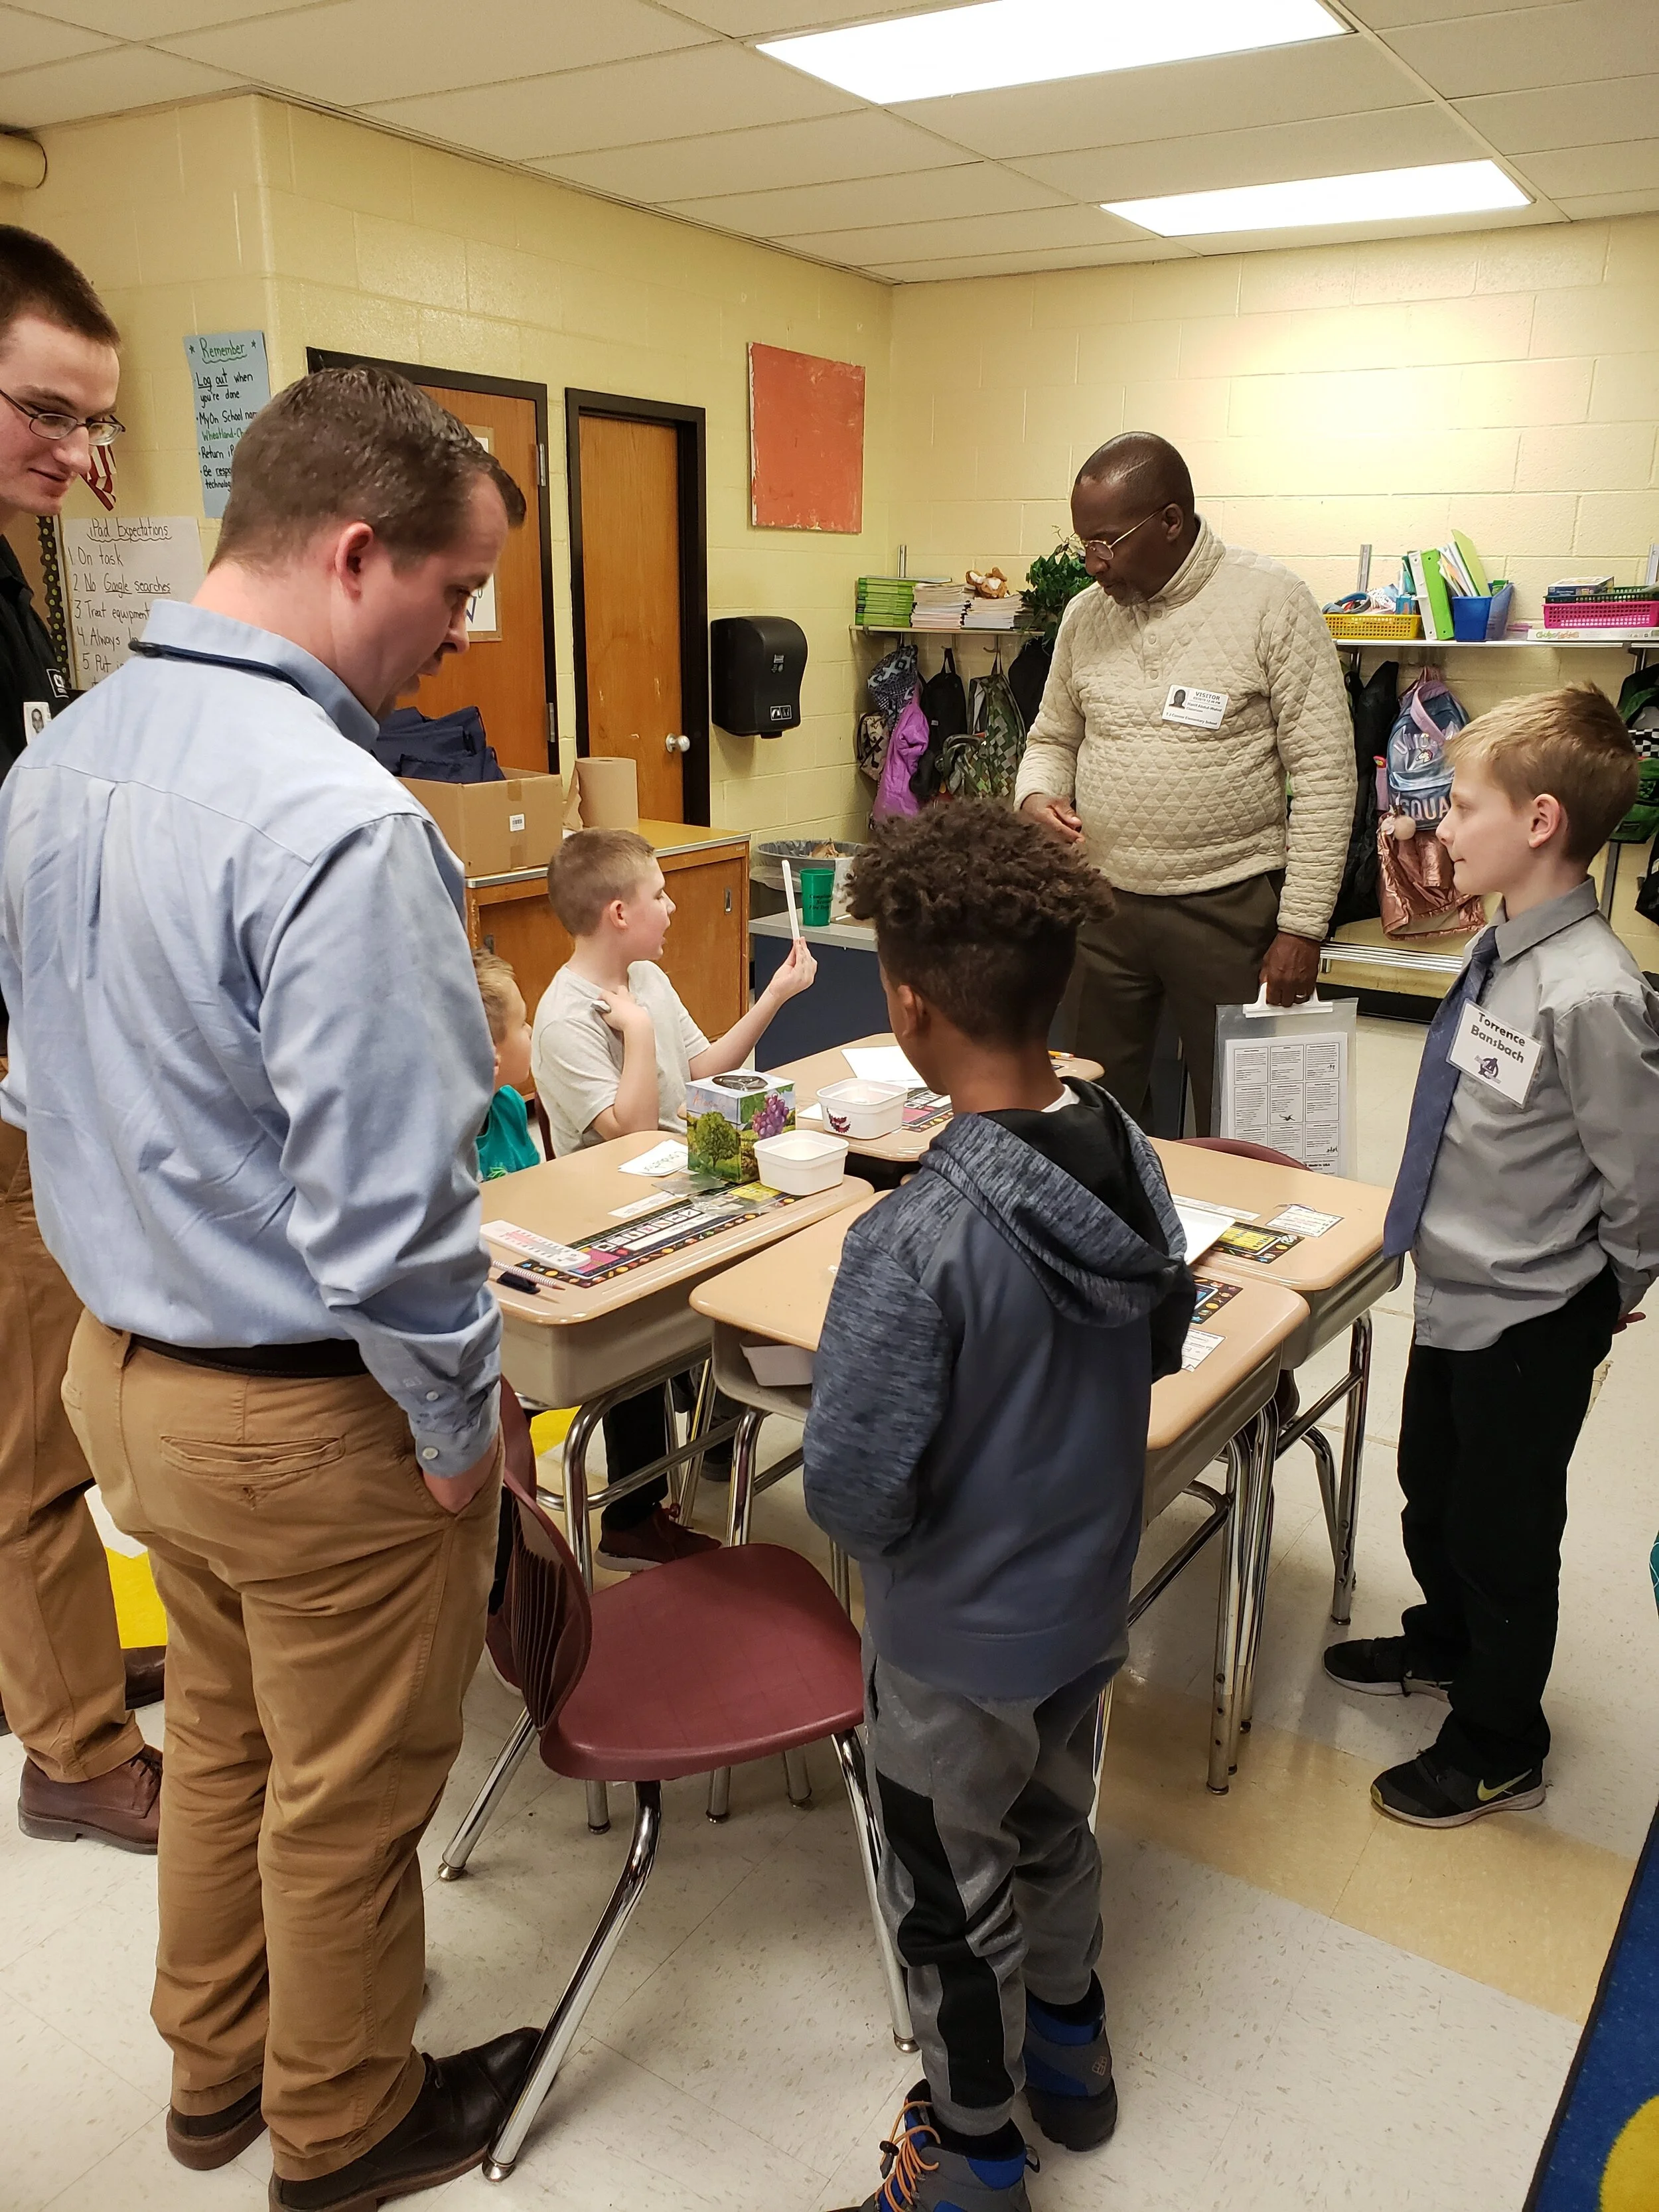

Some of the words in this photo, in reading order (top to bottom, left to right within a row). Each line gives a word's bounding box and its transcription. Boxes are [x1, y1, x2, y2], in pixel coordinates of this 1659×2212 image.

[199, 337, 245, 358] Remember
[196, 372, 212, 392] Log
[216, 367, 228, 385] out
[234, 372, 253, 383] when
[200, 391, 220, 409] you're
[226, 388, 240, 400] done
[199, 412, 219, 429] MyOn
[222, 408, 243, 423] School
[201, 445, 224, 459] Return
[202, 465, 212, 477] Be
[90, 518, 110, 537] iPad
[116, 517, 169, 542] Expectations
[78, 546, 93, 565] On
[100, 544, 123, 566] task
[84, 573, 96, 592] No
[104, 573, 129, 598] Google
[134, 576, 171, 593] searches
[84, 600, 106, 619] Treat
[112, 601, 150, 624] equipment
[90, 627, 120, 652] Always
[96, 654, 111, 673] Put
[1196, 692, 1220, 701] VISITOR
[1479, 1012, 1526, 1047] Torrence
[1471, 1024, 1524, 1063] Bansbach
